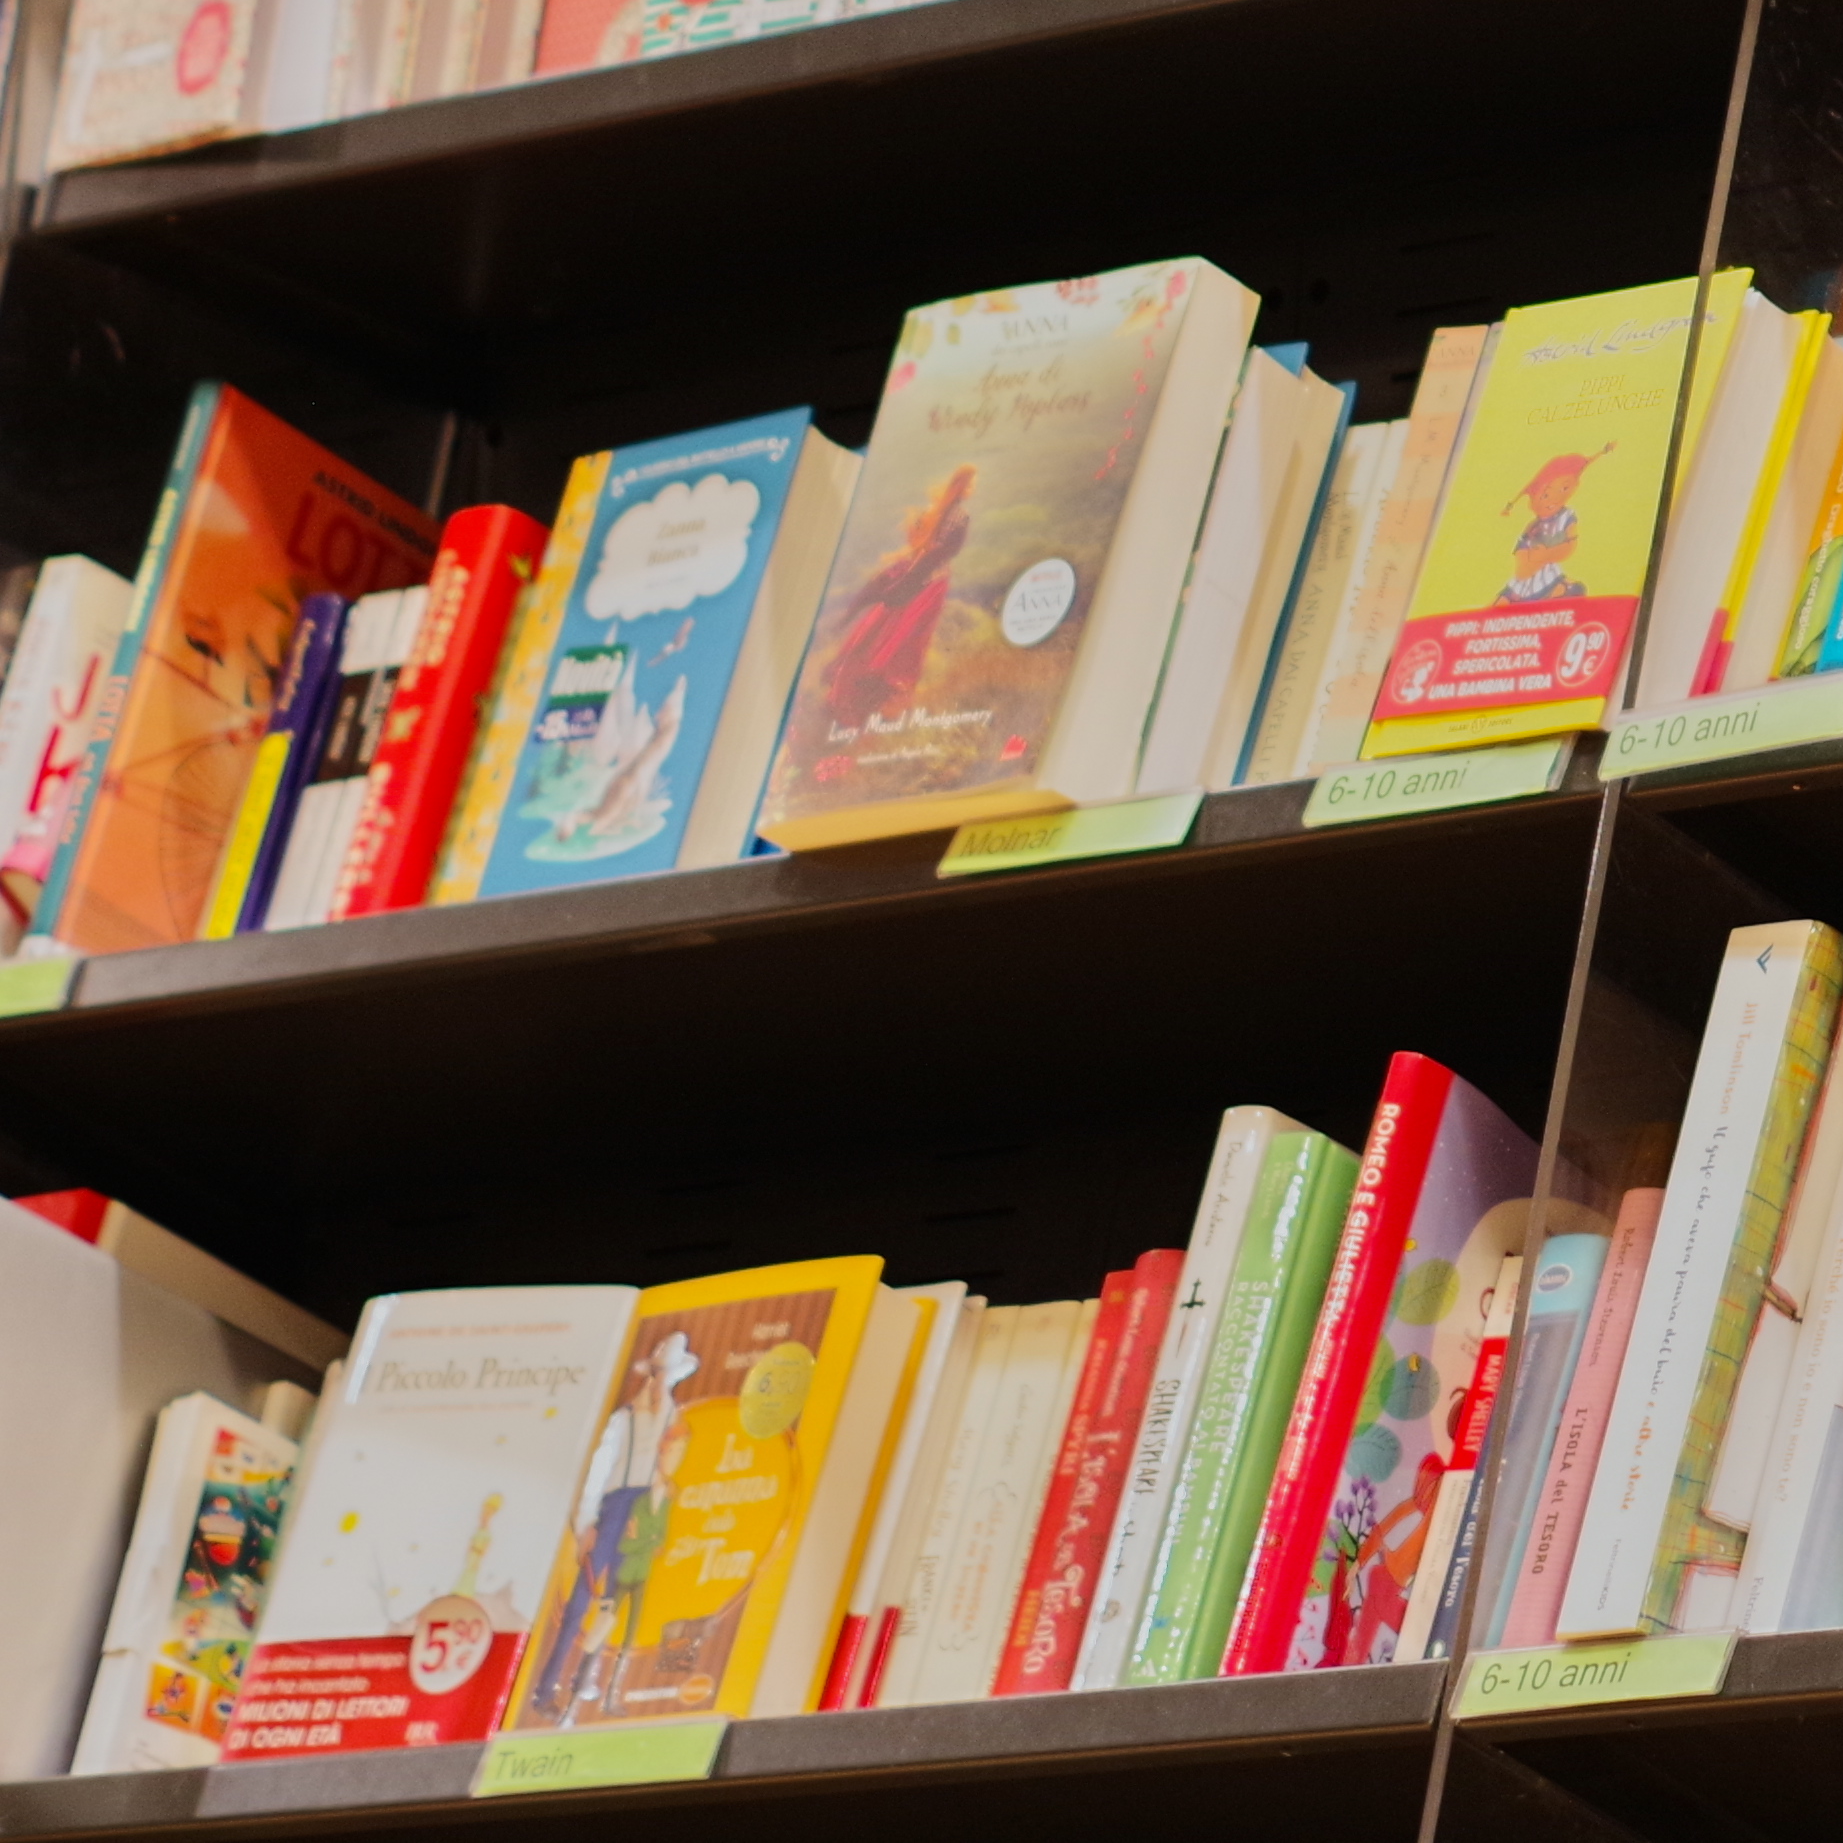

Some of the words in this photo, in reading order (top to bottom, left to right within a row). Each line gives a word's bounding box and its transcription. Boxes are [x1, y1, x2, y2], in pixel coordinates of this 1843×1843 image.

[1446, 618, 1480, 638] PIPPI:
[1483, 610, 1575, 634] INDIPENDENTE,
[1466, 635, 1541, 655] FORTISSIMA,
[1429, 682, 1456, 699] UNA
[1458, 674, 1515, 697] BAMBINA
[1519, 670, 1551, 690] VERA
[828, 721, 859, 742] Lucy
[865, 712, 904, 735] Maud
[910, 709, 992, 728] Montgomery
[1618, 717, 1686, 755] 6-10
[1694, 703, 1761, 743] anni
[1327, 771, 1394, 805] 6-10
[1399, 761, 1470, 797] anni
[958, 822, 1061, 857] Molnar
[1561, 1407, 1589, 1472] L'ISOLA
[1550, 1481, 1564, 1509] del
[1531, 1514, 1557, 1575] TESORO
[1480, 1663, 1552, 1695] 6-10
[1561, 1653, 1633, 1686] anni
[495, 1747, 574, 1778] Twain
